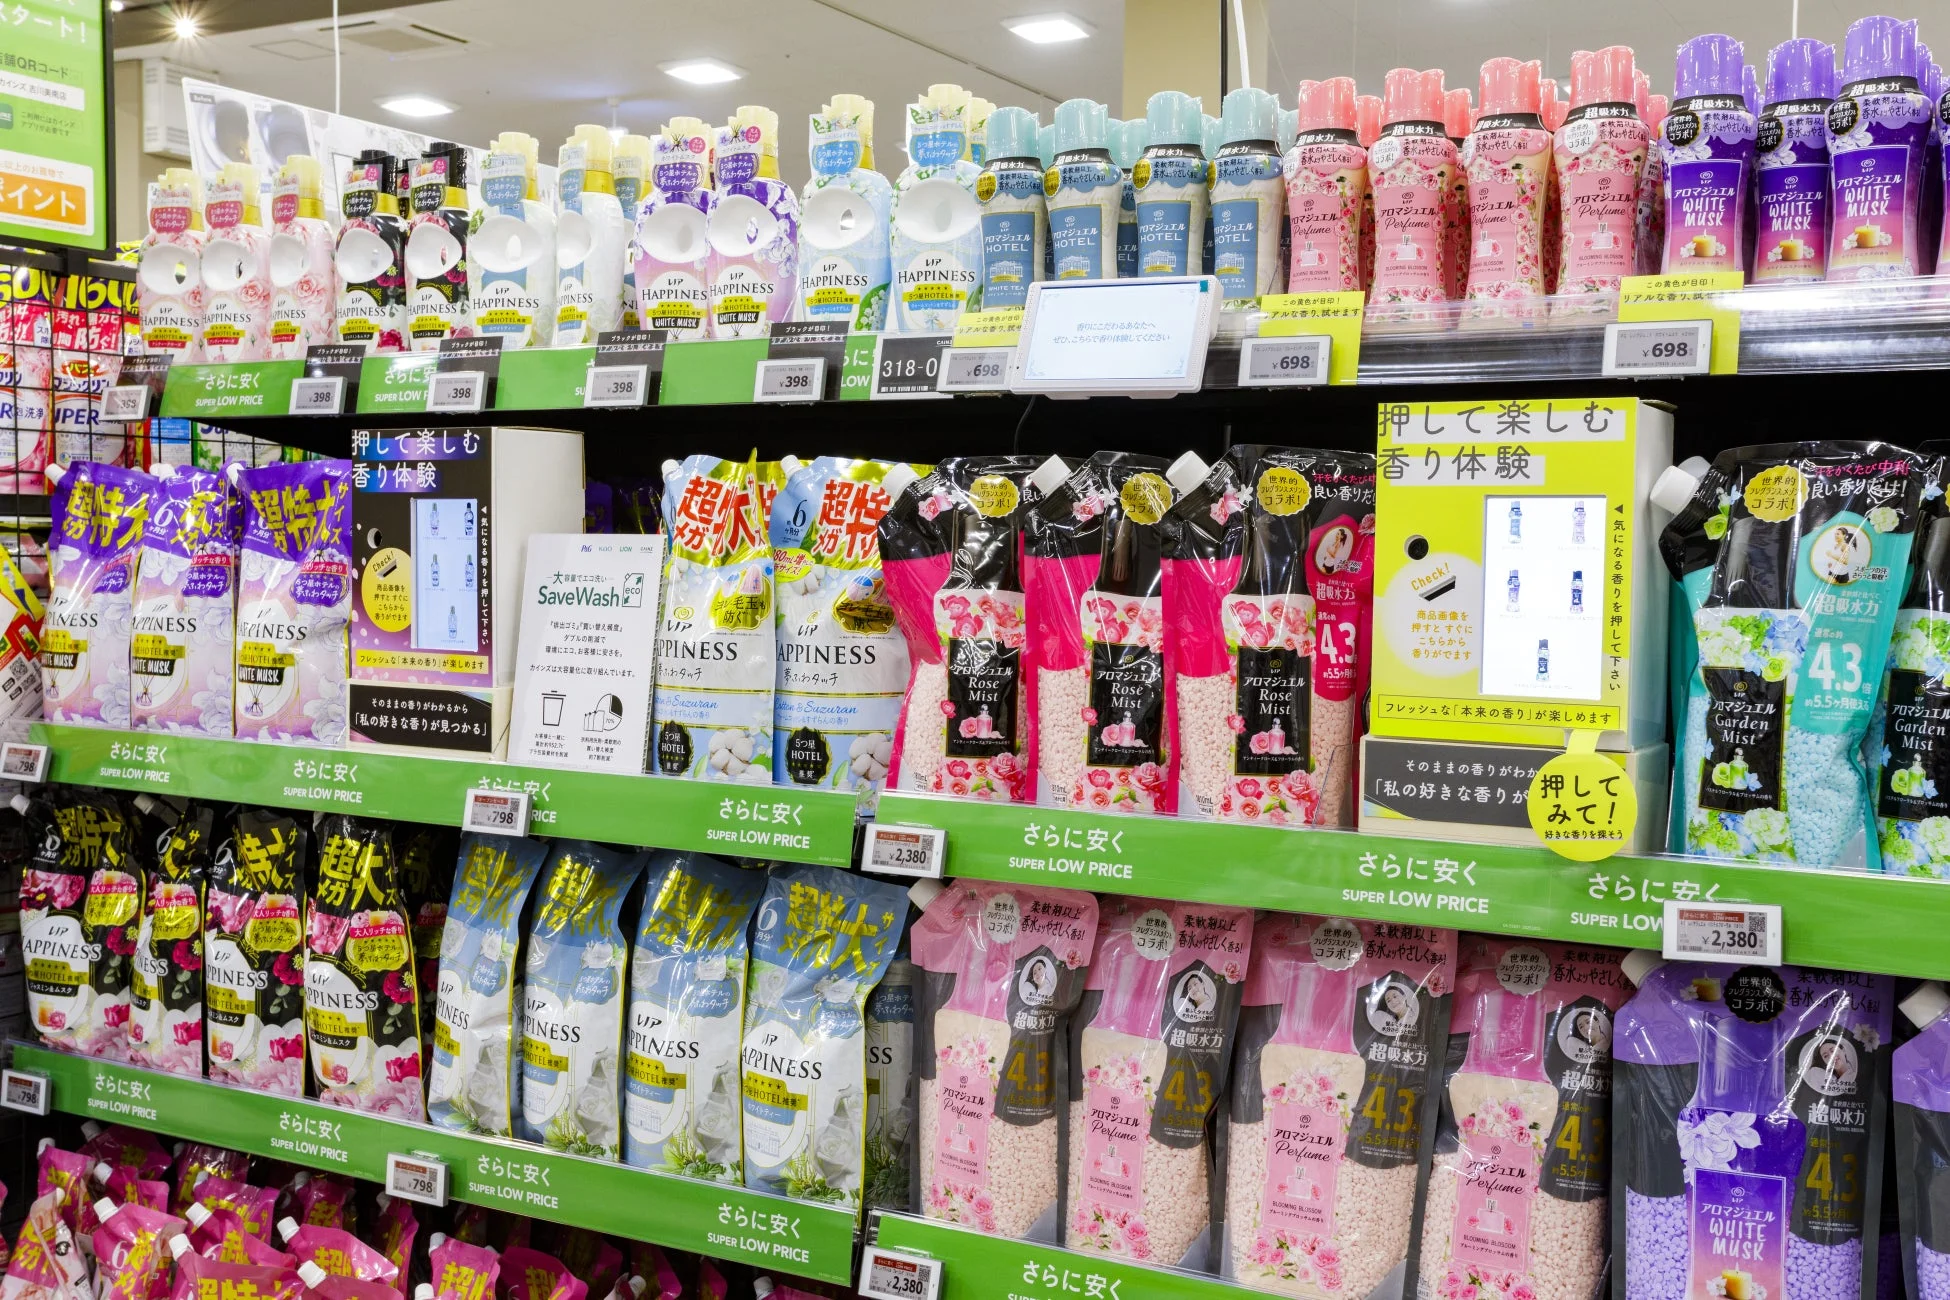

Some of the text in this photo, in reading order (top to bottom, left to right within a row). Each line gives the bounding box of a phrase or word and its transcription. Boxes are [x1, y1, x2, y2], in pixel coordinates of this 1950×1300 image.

[1837, 175, 1902, 188] アロマジュエル
[1674, 187, 1735, 199] アロマジュエル
[1845, 186, 1891, 202] WHITE
[1578, 204, 1627, 218] Perfume
[1683, 197, 1725, 212] WHITE
[1769, 201, 1813, 217] WHITE
[1847, 201, 1889, 217] MUSK
[1685, 211, 1723, 226] MUSK
[1772, 216, 1811, 232] MUSK
[1054, 237, 1096, 248] HOTEL
[1140, 233, 1182, 243] HOTEL
[986, 243, 1029, 253] HOTEL
[802, 274, 868, 286] HAPPINESS
[898, 271, 975, 284] HAPPINESS
[1647, 279, 1715, 290] この黄色が目印！
[709, 282, 775, 295] HAPPINESS
[408, 304, 457, 316] HAPPINESS
[472, 297, 540, 310] HAPPINESS
[337, 307, 386, 319] HAPPINESS
[1076, 321, 1156, 333] 香りにこだわるあなたへ
[1053, 334, 1171, 345] ぜひ、こちらで香り体験してください
[1642, 342, 1689, 359] ¥698
[1272, 355, 1311, 371] ¥698
[778, 375, 809, 389] ¥398
[195, 393, 264, 407] SUPER LOW PRICE
[1378, 400, 1614, 438] 押して楽しむ
[352, 428, 481, 457] 押して楽しむ
[1377, 444, 1532, 481] 香り体験
[352, 461, 438, 489] 香り体験
[1760, 474, 1797, 488] 世界的
[1264, 493, 1302, 506] コラボ！
[792, 498, 808, 528] 6
[372, 550, 394, 573] Check!
[480, 517, 490, 645] 気になる香りを押して下さい
[552, 571, 608, 585] 大容量でエコ洗い
[1410, 562, 1450, 592] Check!
[537, 585, 641, 608] SaveWash eco
[1315, 581, 1356, 602] 超吸水力
[1607, 518, 1627, 692] 気になる香りを押して下さい
[1416, 609, 1470, 622] 商品画像を
[1411, 621, 1474, 635] 押すと すぐに
[1319, 621, 1357, 666] 4.3
[1418, 636, 1468, 648] こちらから
[1412, 647, 1472, 661] 香りがでます
[1807, 641, 1863, 691] 4.3
[968, 675, 1000, 690] Rose
[1111, 682, 1144, 696] Rose
[1243, 676, 1306, 689] アロマジュエル
[968, 689, 998, 703] Mist
[1111, 695, 1142, 710] Mist
[1259, 687, 1293, 702] Rose
[371, 698, 469, 714] そのままの香りがわかるから
[803, 702, 859, 716] Suzuran
[1259, 701, 1292, 716] Mist
[1384, 701, 1613, 726] フレッシュな「本来の香り」が楽しめます
[1712, 699, 1777, 716] アロマジュエル
[354, 713, 488, 737] 「私の好きな香りが見つかる」
[1714, 714, 1770, 732] Garden
[1894, 716, 1947, 737] Garden
[1720, 730, 1757, 746] Mist
[1901, 734, 1935, 752] Mist
[109, 741, 168, 764] さらに安く
[661, 741, 686, 755] HOTEL
[791, 748, 823, 762] HOTEL
[99, 766, 170, 784] SUPER LOW PRICE
[292, 758, 359, 784] さらに安く
[283, 785, 363, 804] SUPER LOW PRICE
[1539, 773, 1621, 800] 押して
[486, 810, 514, 825] ¥798
[719, 797, 803, 827] さらに安く
[1546, 804, 1616, 826] みて！
[706, 828, 811, 850] SUPER LOW PRICE
[1023, 822, 1126, 854] さらに安く
[1544, 828, 1624, 841] 好きな香りを探そう
[888, 847, 928, 865] ¥2,380
[1008, 855, 1134, 880] SUPER LOW PRICE
[1357, 850, 1478, 887] さらに安く
[1341, 887, 1490, 915] SUPER LOW PRICE
[757, 896, 778, 932] 6
[1029, 900, 1081, 921] 柔軟剤以上
[1183, 914, 1238, 934] 柔軟剤以上
[1323, 927, 1353, 940] 世界的
[1374, 926, 1439, 944] 柔軟剤以上
[1701, 929, 1759, 951] ¥2,380
[1314, 947, 1353, 962] コラボ！
[94, 1072, 151, 1102] さらに安く
[86, 1098, 157, 1122] SUPER LOW PRICE
[942, 1099, 984, 1121] Perfume
[1807, 1102, 1866, 1126] 超吸水力
[278, 1111, 344, 1143] さらに安く
[1090, 1120, 1138, 1143] Perfume
[1274, 1141, 1331, 1163] Perfume
[477, 1154, 552, 1188] さらに安く
[716, 1202, 801, 1240] さらに安く
[1700, 1203, 1776, 1223] アロマジュエル
[1708, 1218, 1768, 1242] WHITE
[1712, 1238, 1765, 1262] MUSK
[886, 1275, 925, 1296] ¥2,380
